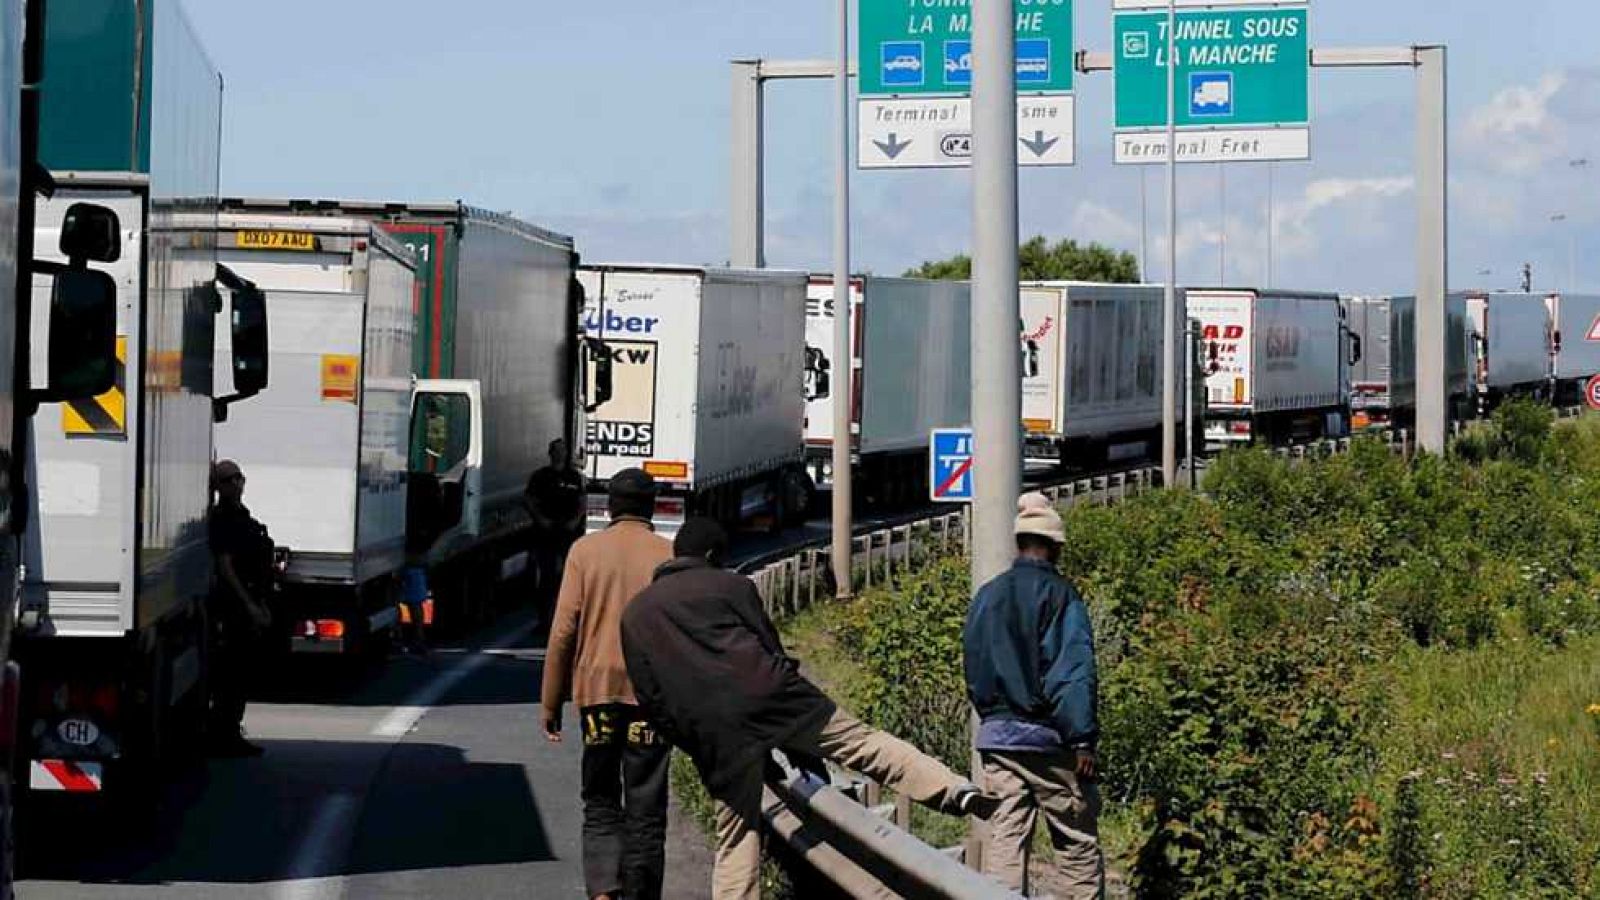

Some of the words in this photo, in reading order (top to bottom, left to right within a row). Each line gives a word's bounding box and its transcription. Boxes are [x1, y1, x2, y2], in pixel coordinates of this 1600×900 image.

[907, 14, 933, 34] LA
[1242, 17, 1299, 38] SOUS
[1188, 44, 1278, 65] MANCHE
[875, 104, 958, 122] Terminal
[1122, 138, 1207, 157] Termnal
[1220, 138, 1260, 155] Fret
[244, 232, 278, 246] DX07
[584, 309, 659, 333] uber
[610, 348, 651, 364] KW
[587, 422, 652, 442] ENDS
[608, 443, 652, 457] road
[67, 721, 89, 743] CH
